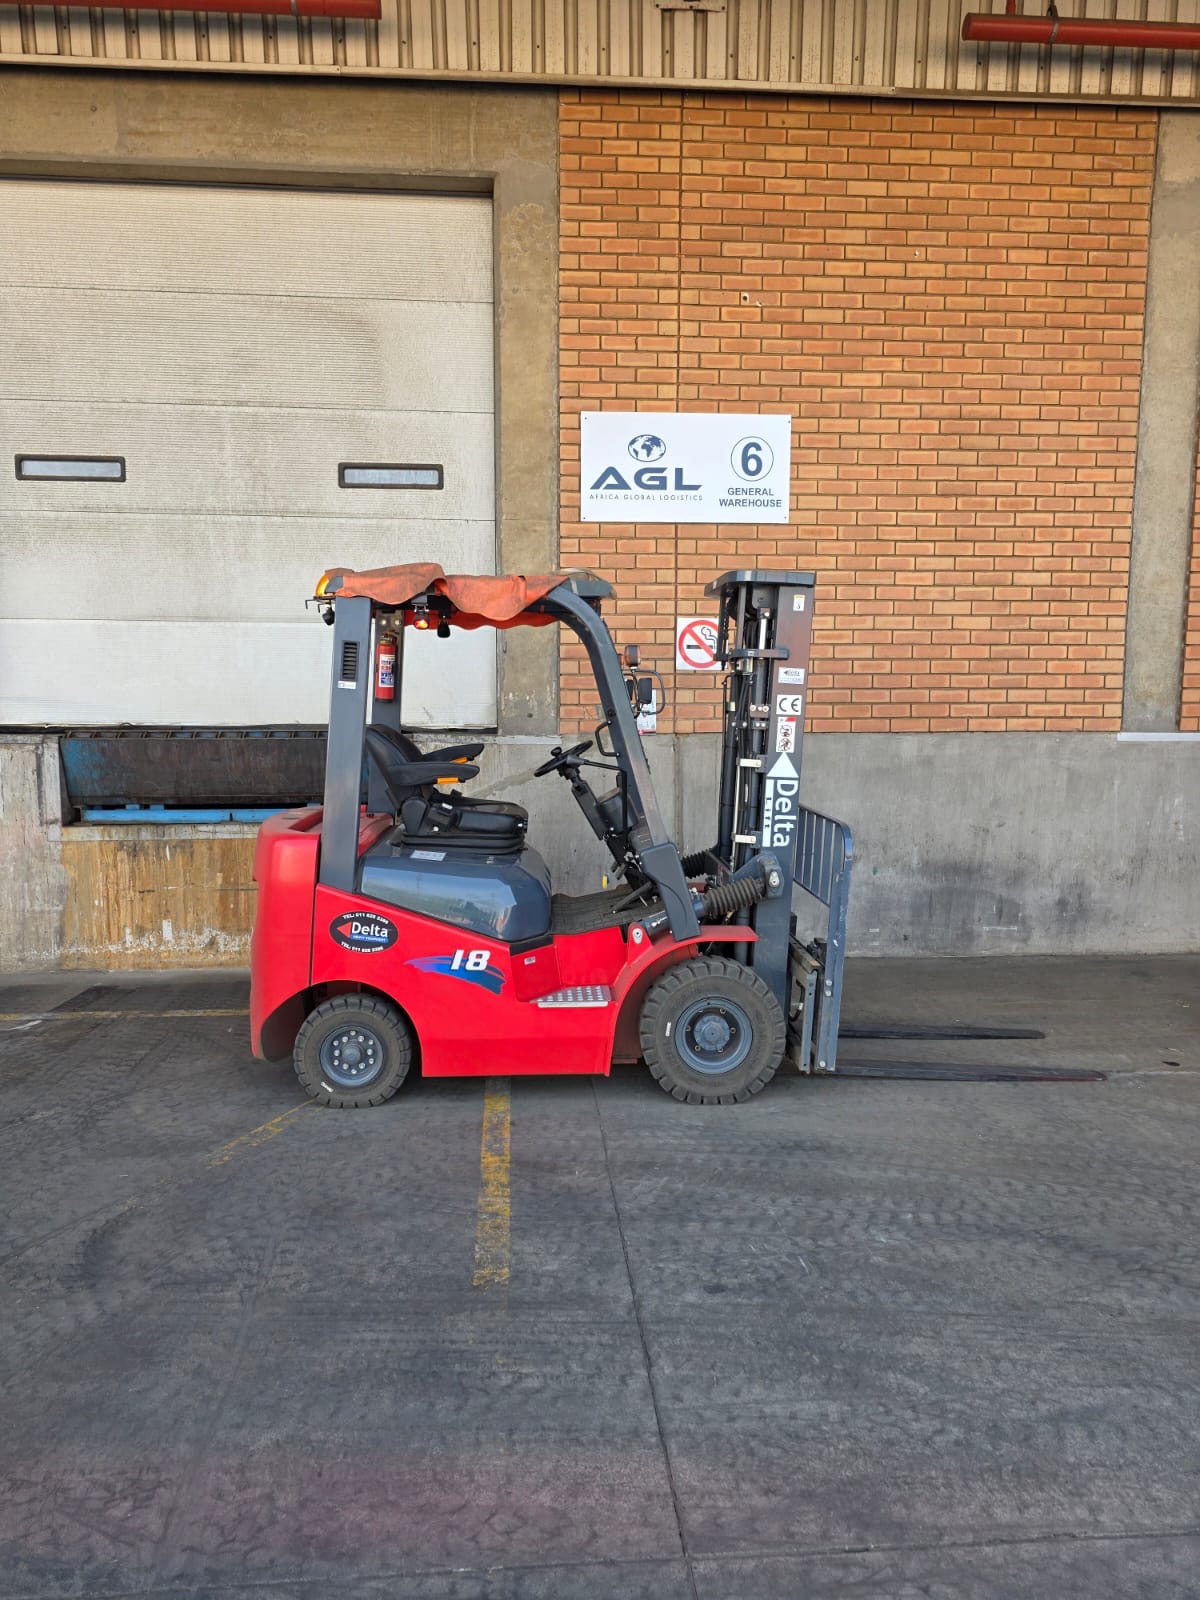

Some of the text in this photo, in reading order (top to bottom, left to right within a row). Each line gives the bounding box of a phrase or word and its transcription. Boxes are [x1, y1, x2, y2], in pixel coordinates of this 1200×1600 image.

[741, 441, 763, 476] 6
[589, 466, 703, 491] AGL
[719, 498, 783, 507] WAREHOUSE
[727, 487, 774, 496] GENERAL
[773, 779, 799, 848] Delta
[352, 921, 388, 938] Delta
[450, 949, 491, 971] 18
